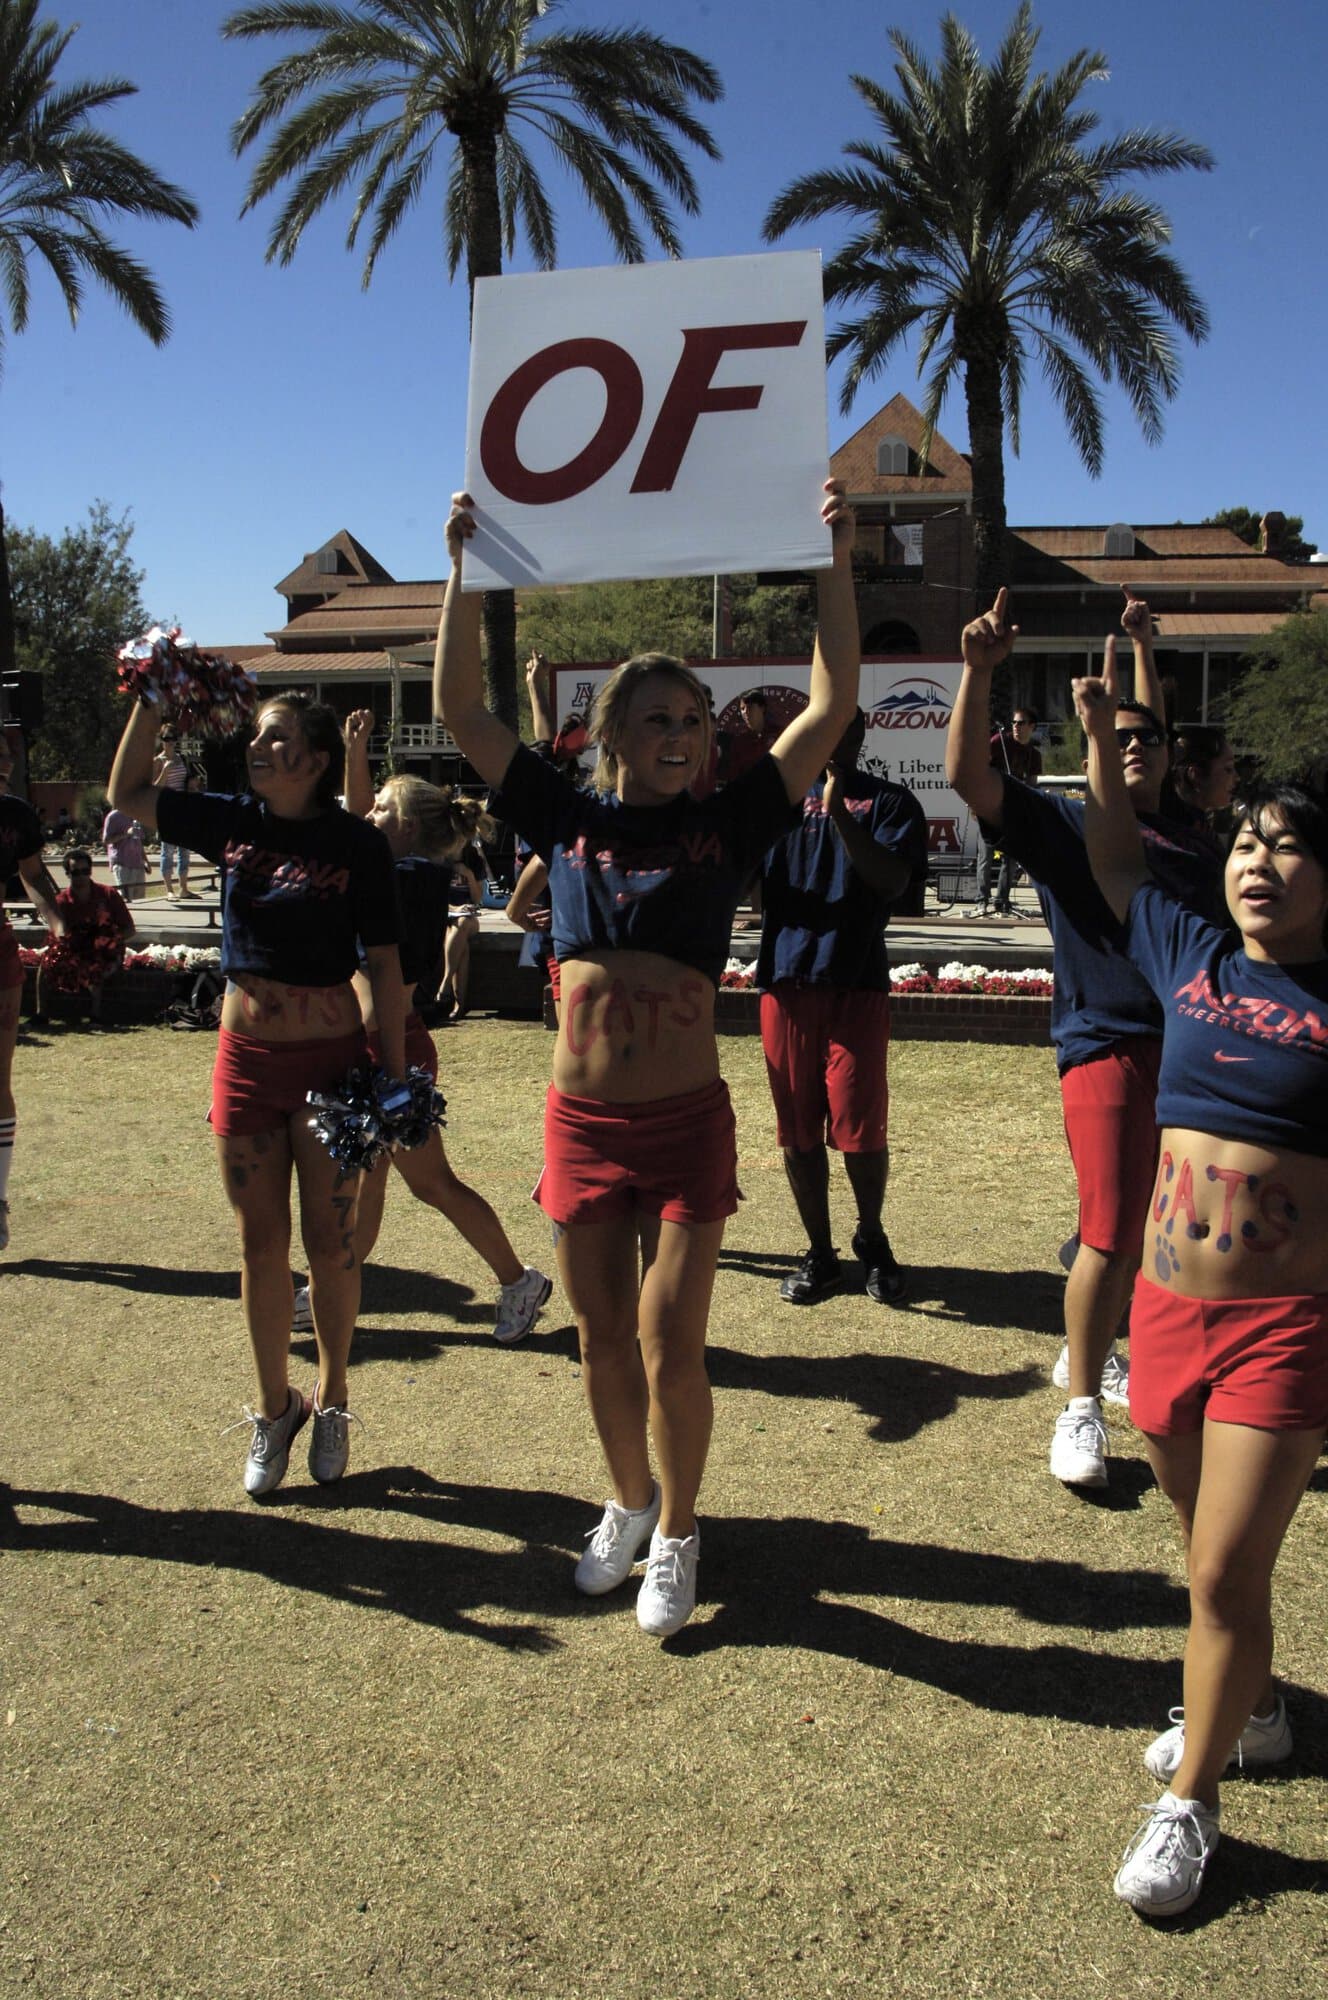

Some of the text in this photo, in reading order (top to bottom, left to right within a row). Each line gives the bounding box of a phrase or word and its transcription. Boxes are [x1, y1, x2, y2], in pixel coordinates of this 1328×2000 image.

[480, 320, 808, 505] OF
[785, 688, 809, 705] Fron
[899, 759, 944, 774] Liber
[900, 777, 953, 790] Mutua
[567, 977, 704, 1057] CATS
[1152, 1151, 1299, 1253] CATS
